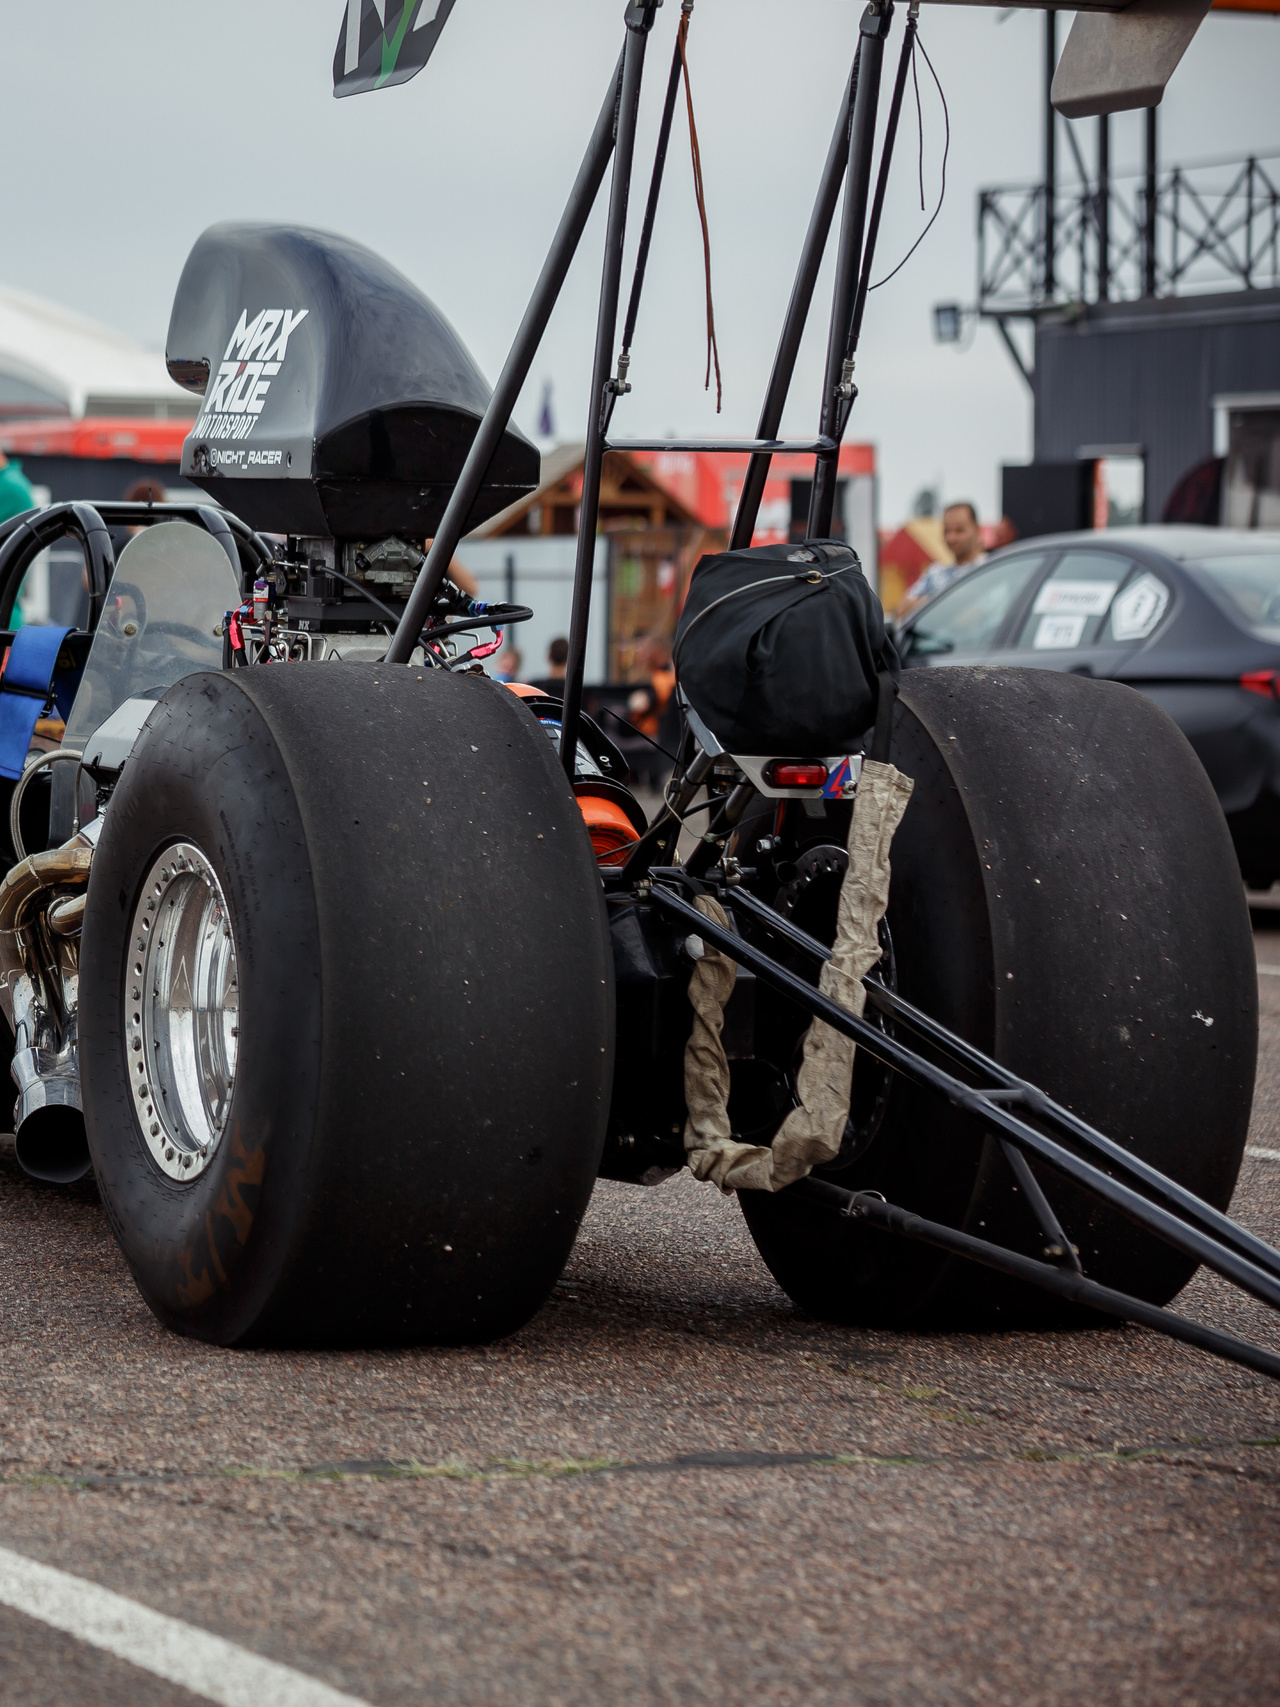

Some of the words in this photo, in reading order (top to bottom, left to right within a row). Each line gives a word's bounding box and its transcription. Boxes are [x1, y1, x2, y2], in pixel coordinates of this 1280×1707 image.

[223, 308, 309, 361] MAX
[204, 362, 282, 413] RIDE
[193, 415, 258, 439] MOTORSPORT
[298, 619, 310, 631] NX
